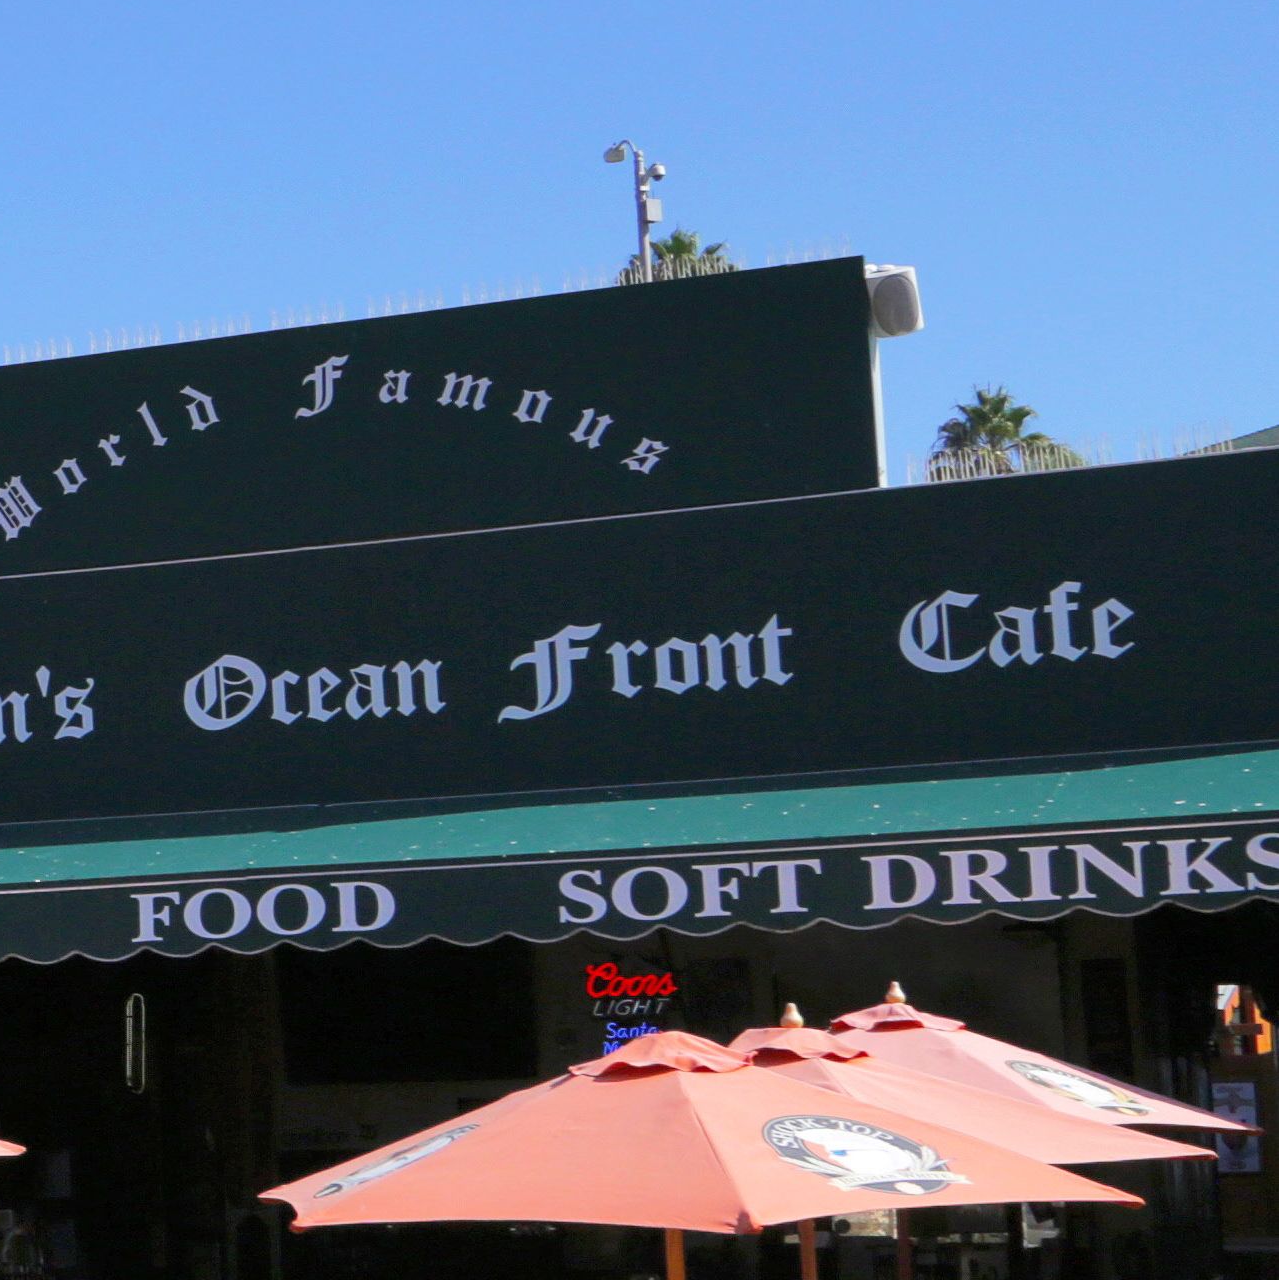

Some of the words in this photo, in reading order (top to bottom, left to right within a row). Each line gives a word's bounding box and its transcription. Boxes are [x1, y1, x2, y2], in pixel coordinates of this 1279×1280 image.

[295, 355, 669, 474] Famous
[184, 655, 446, 730] Ocean
[498, 614, 793, 723] Front
[899, 582, 1134, 673] Cafe
[130, 882, 395, 942] FOOD
[559, 859, 821, 923] SOFT
[860, 831, 1279, 910] DRINKS
[585, 962, 679, 998] Coors
[593, 999, 670, 1016] LIGHT
[771, 1118, 823, 1148] SHOCK
[834, 1120, 894, 1141] TOP
